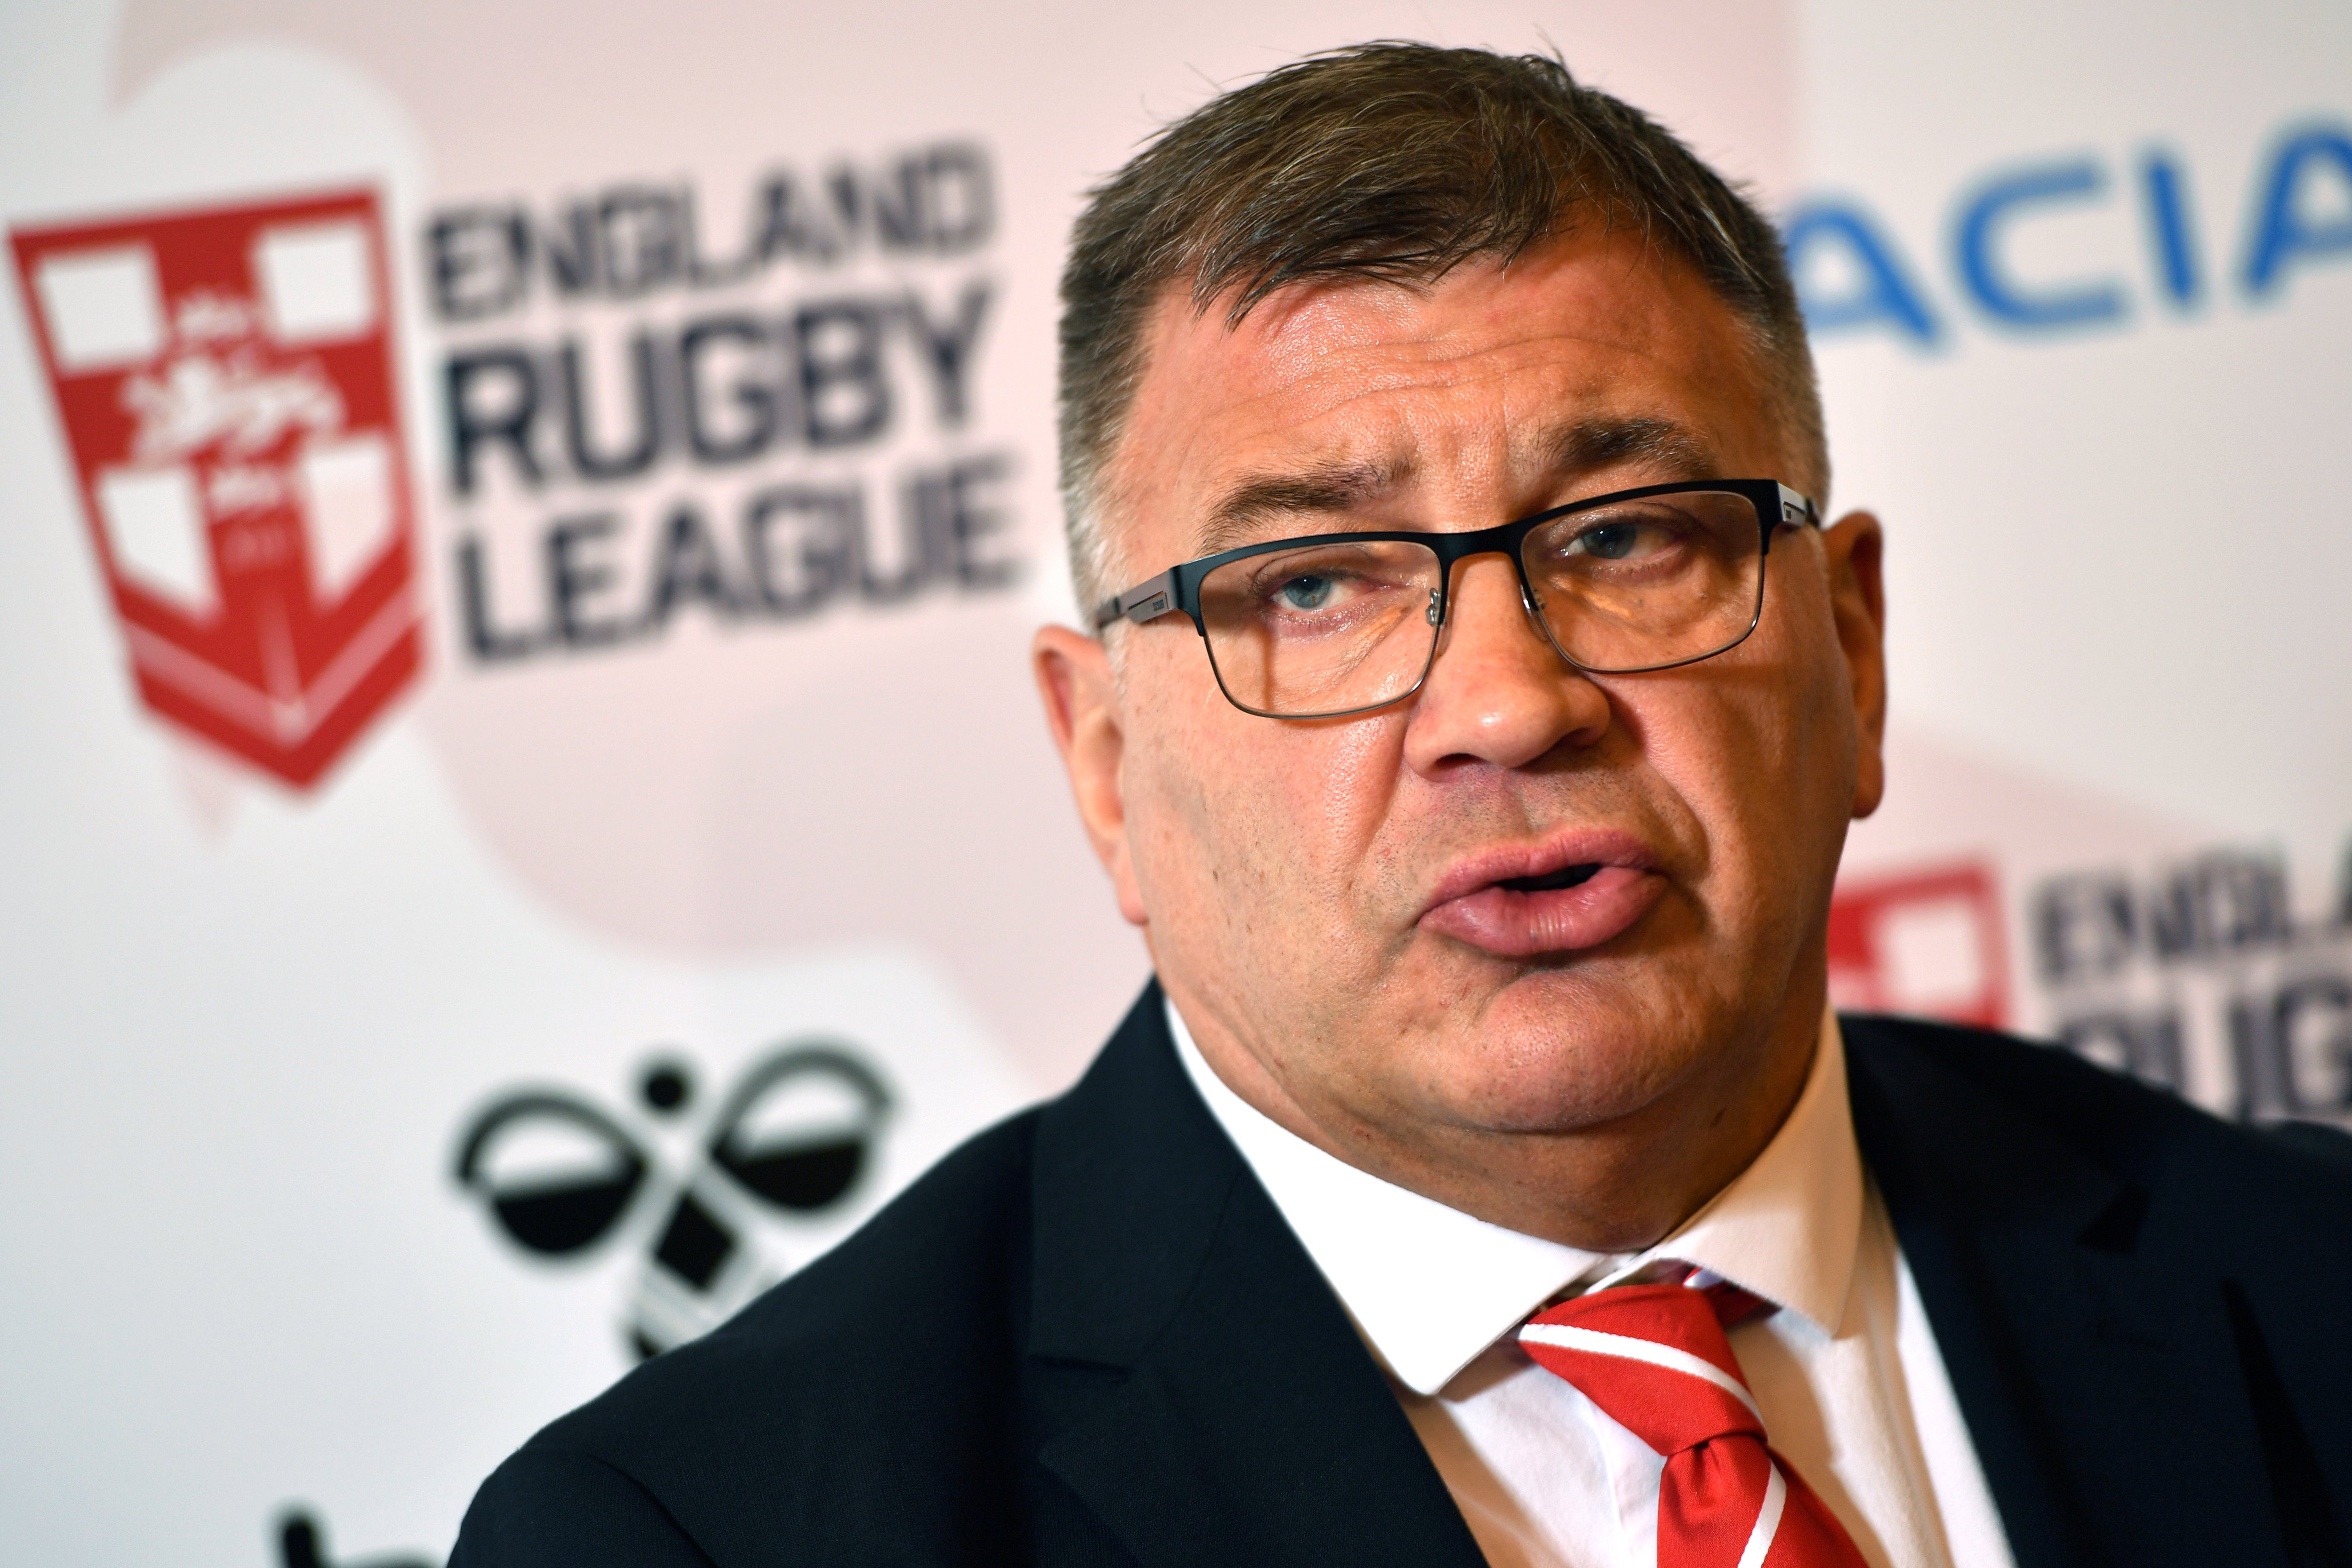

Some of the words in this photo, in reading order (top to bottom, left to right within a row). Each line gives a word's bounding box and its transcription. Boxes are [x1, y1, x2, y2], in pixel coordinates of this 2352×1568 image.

[427, 140, 998, 319] ENGLAND
[444, 277, 998, 496] RUGBY
[461, 452, 1025, 664] LEAGUE
